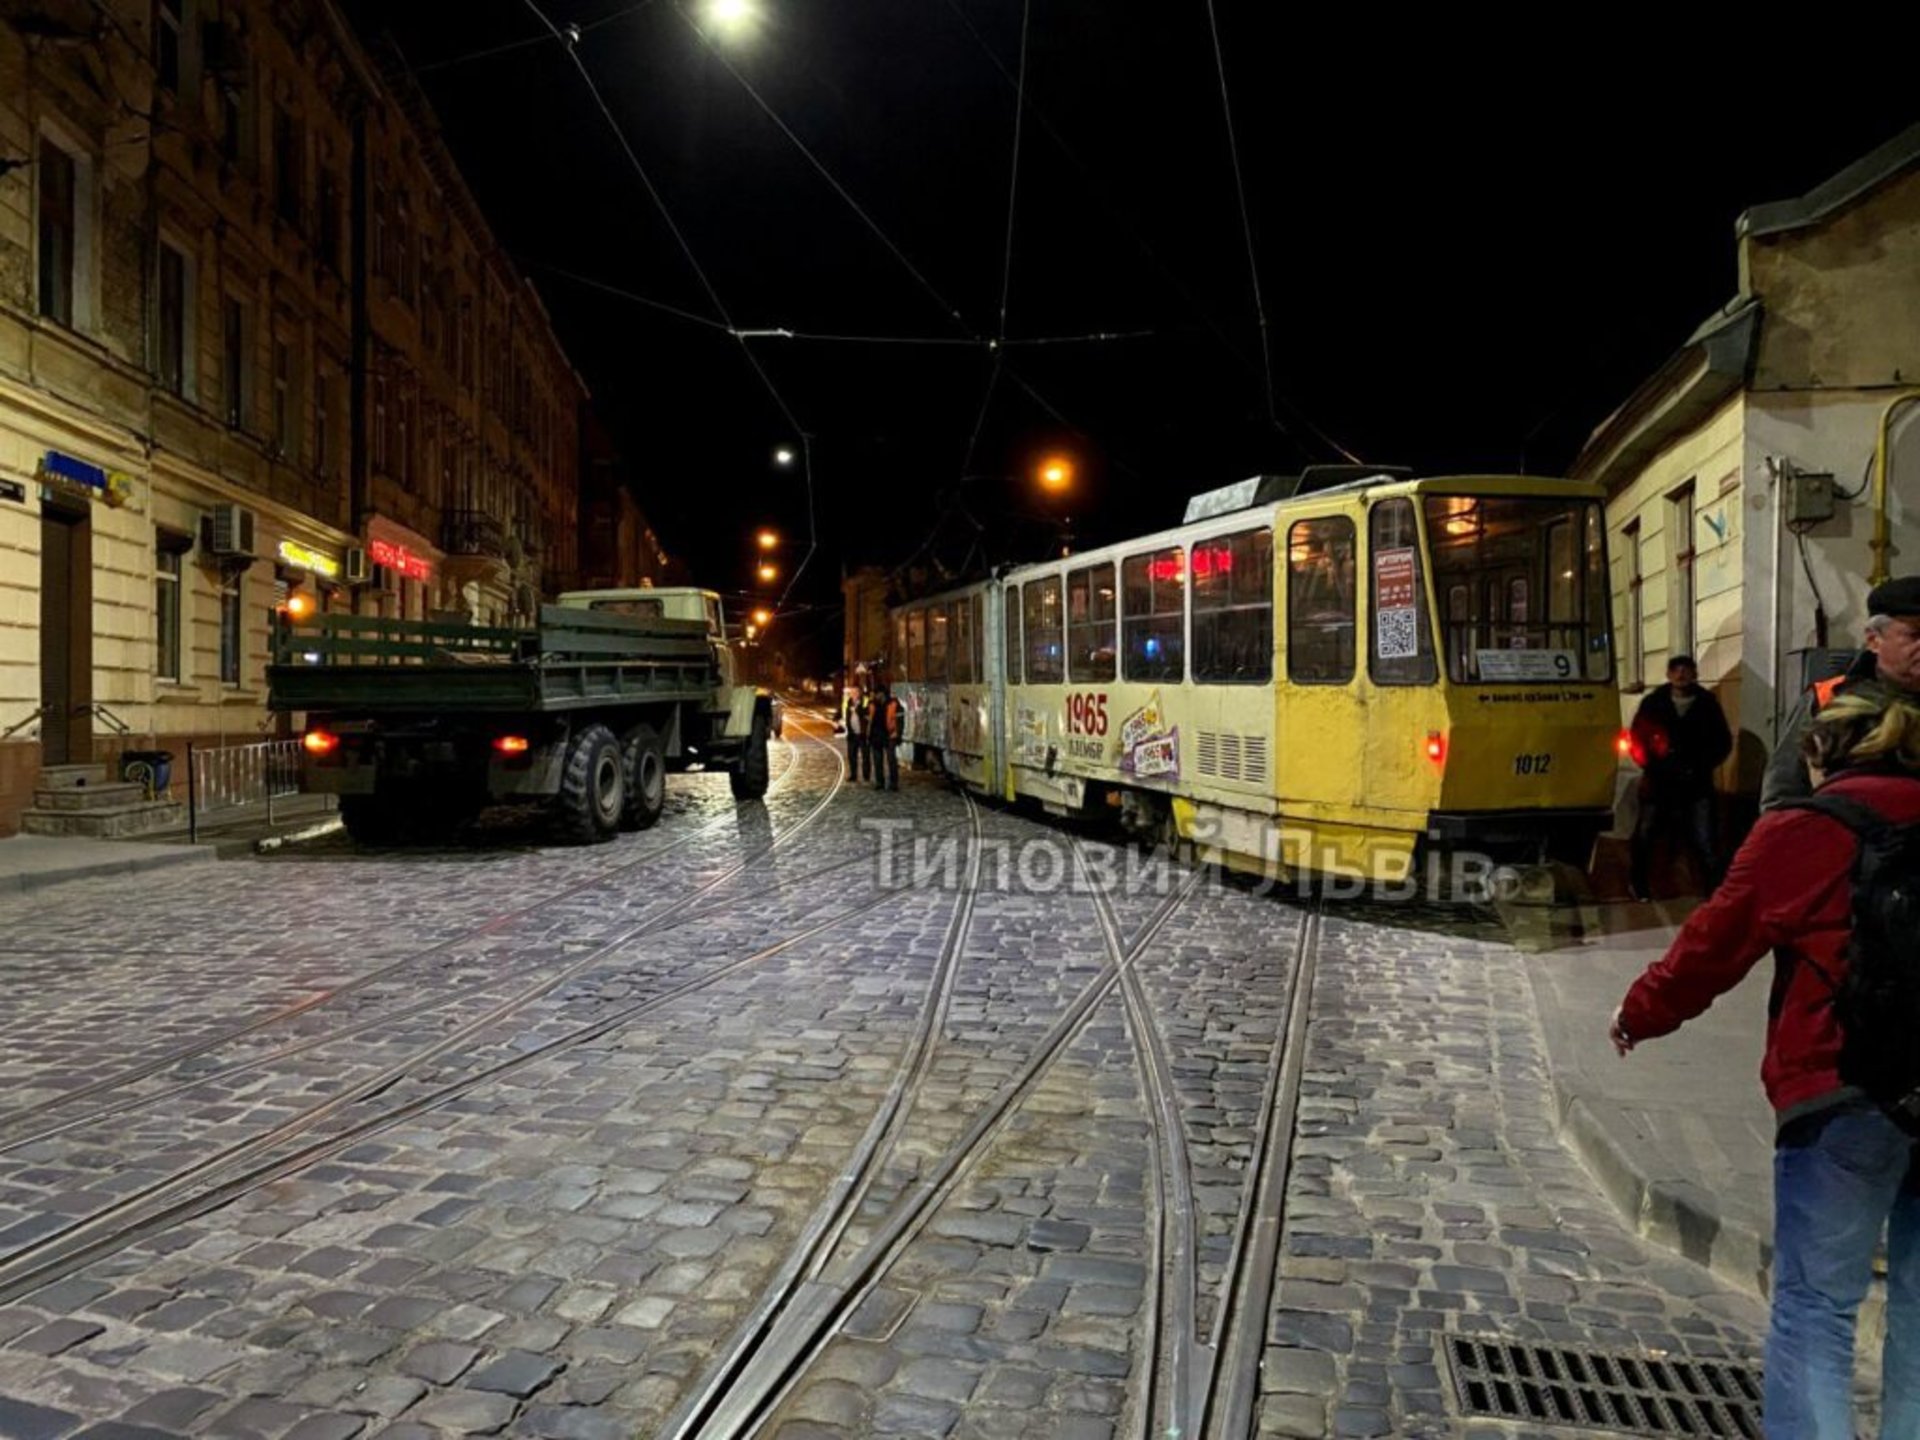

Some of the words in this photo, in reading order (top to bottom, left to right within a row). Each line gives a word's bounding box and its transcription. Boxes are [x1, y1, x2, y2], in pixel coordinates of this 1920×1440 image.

[1553, 654, 1571, 677] 9
[1065, 692, 1108, 736] 1965
[1514, 753, 1552, 775] 1012
